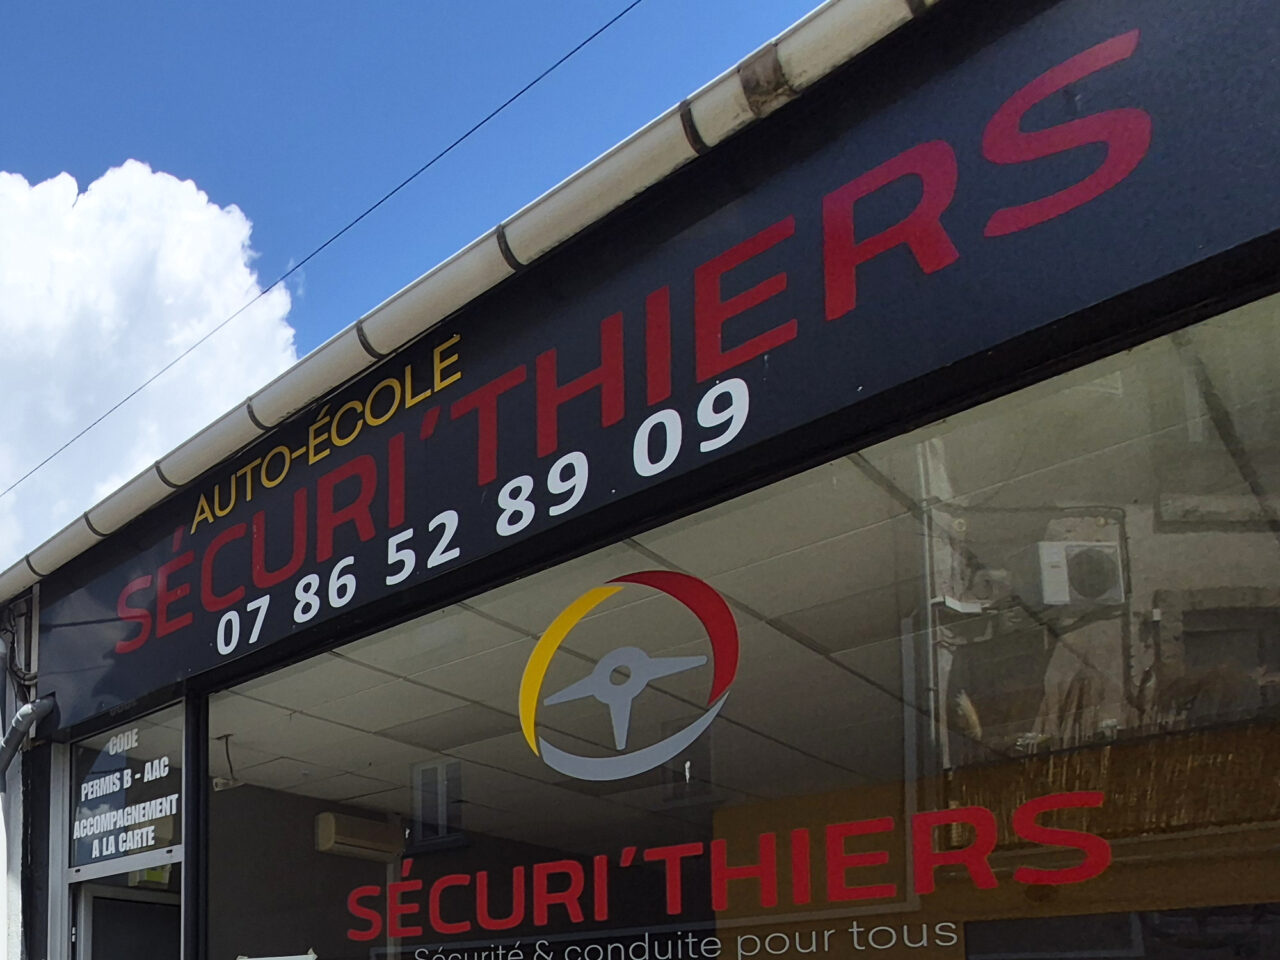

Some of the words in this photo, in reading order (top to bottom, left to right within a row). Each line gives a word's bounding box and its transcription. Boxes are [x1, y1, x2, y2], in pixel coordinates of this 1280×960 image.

[115, 29, 1153, 655] SÉCURI'THIERS
[190, 334, 462, 534] AUTO-ÉCOLE
[216, 594, 270, 656] 07
[293, 556, 357, 624] 86
[385, 510, 460, 586] 52
[496, 451, 589, 537] 89
[633, 377, 750, 477] 09
[108, 728, 138, 756] CODE
[81, 772, 121, 802] PERMIS
[123, 768, 132, 789] B
[143, 756, 169, 783] AAC
[73, 793, 179, 840] ACCOMPAGNEMENT
[91, 838, 100, 859] A
[102, 834, 116, 856] LA
[118, 825, 155, 853] CARTE
[347, 790, 1113, 941] SÉCURI'THIERS
[848, 921, 959, 950] tous
